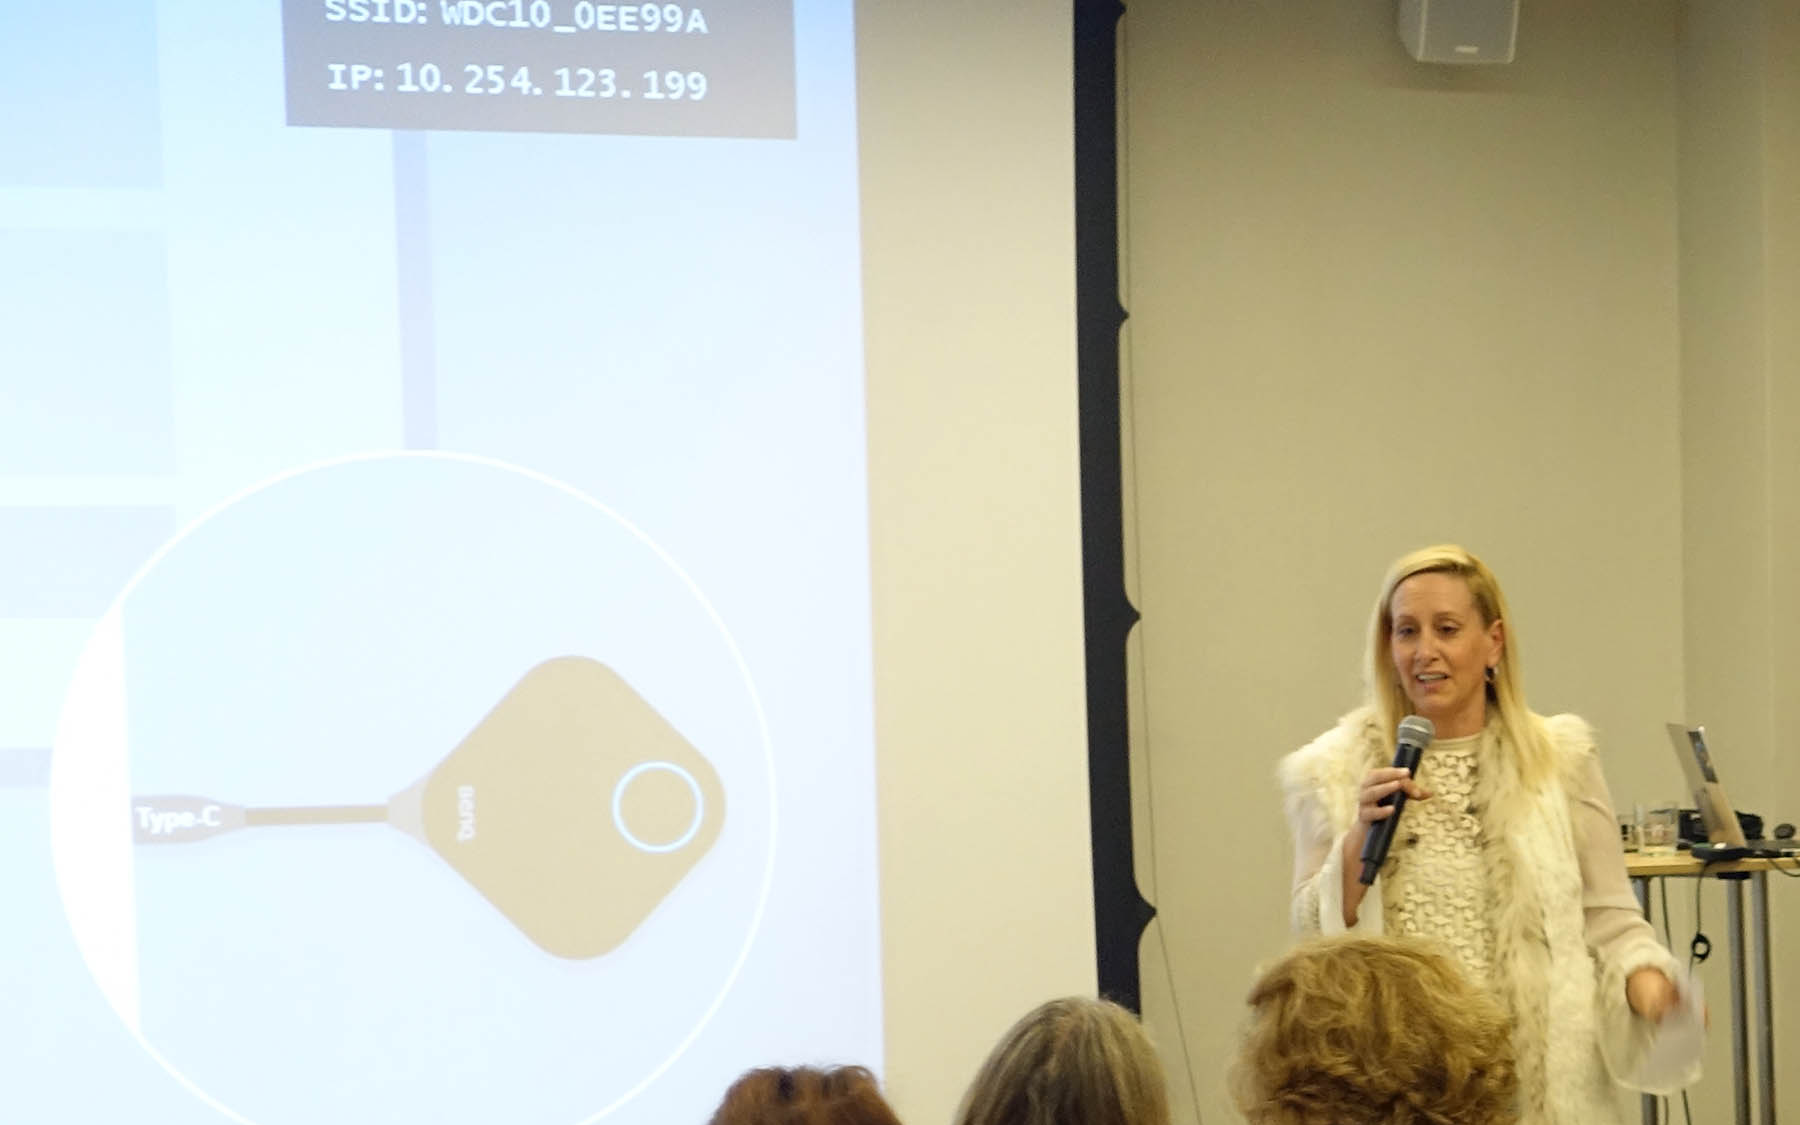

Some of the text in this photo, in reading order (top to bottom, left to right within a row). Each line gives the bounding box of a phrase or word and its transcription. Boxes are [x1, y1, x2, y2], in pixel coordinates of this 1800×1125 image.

[325, 0, 709, 34] SSID: WDC10_0EE99A
[328, 64, 385, 91] IP:
[135, 806, 221, 834] Type-C
